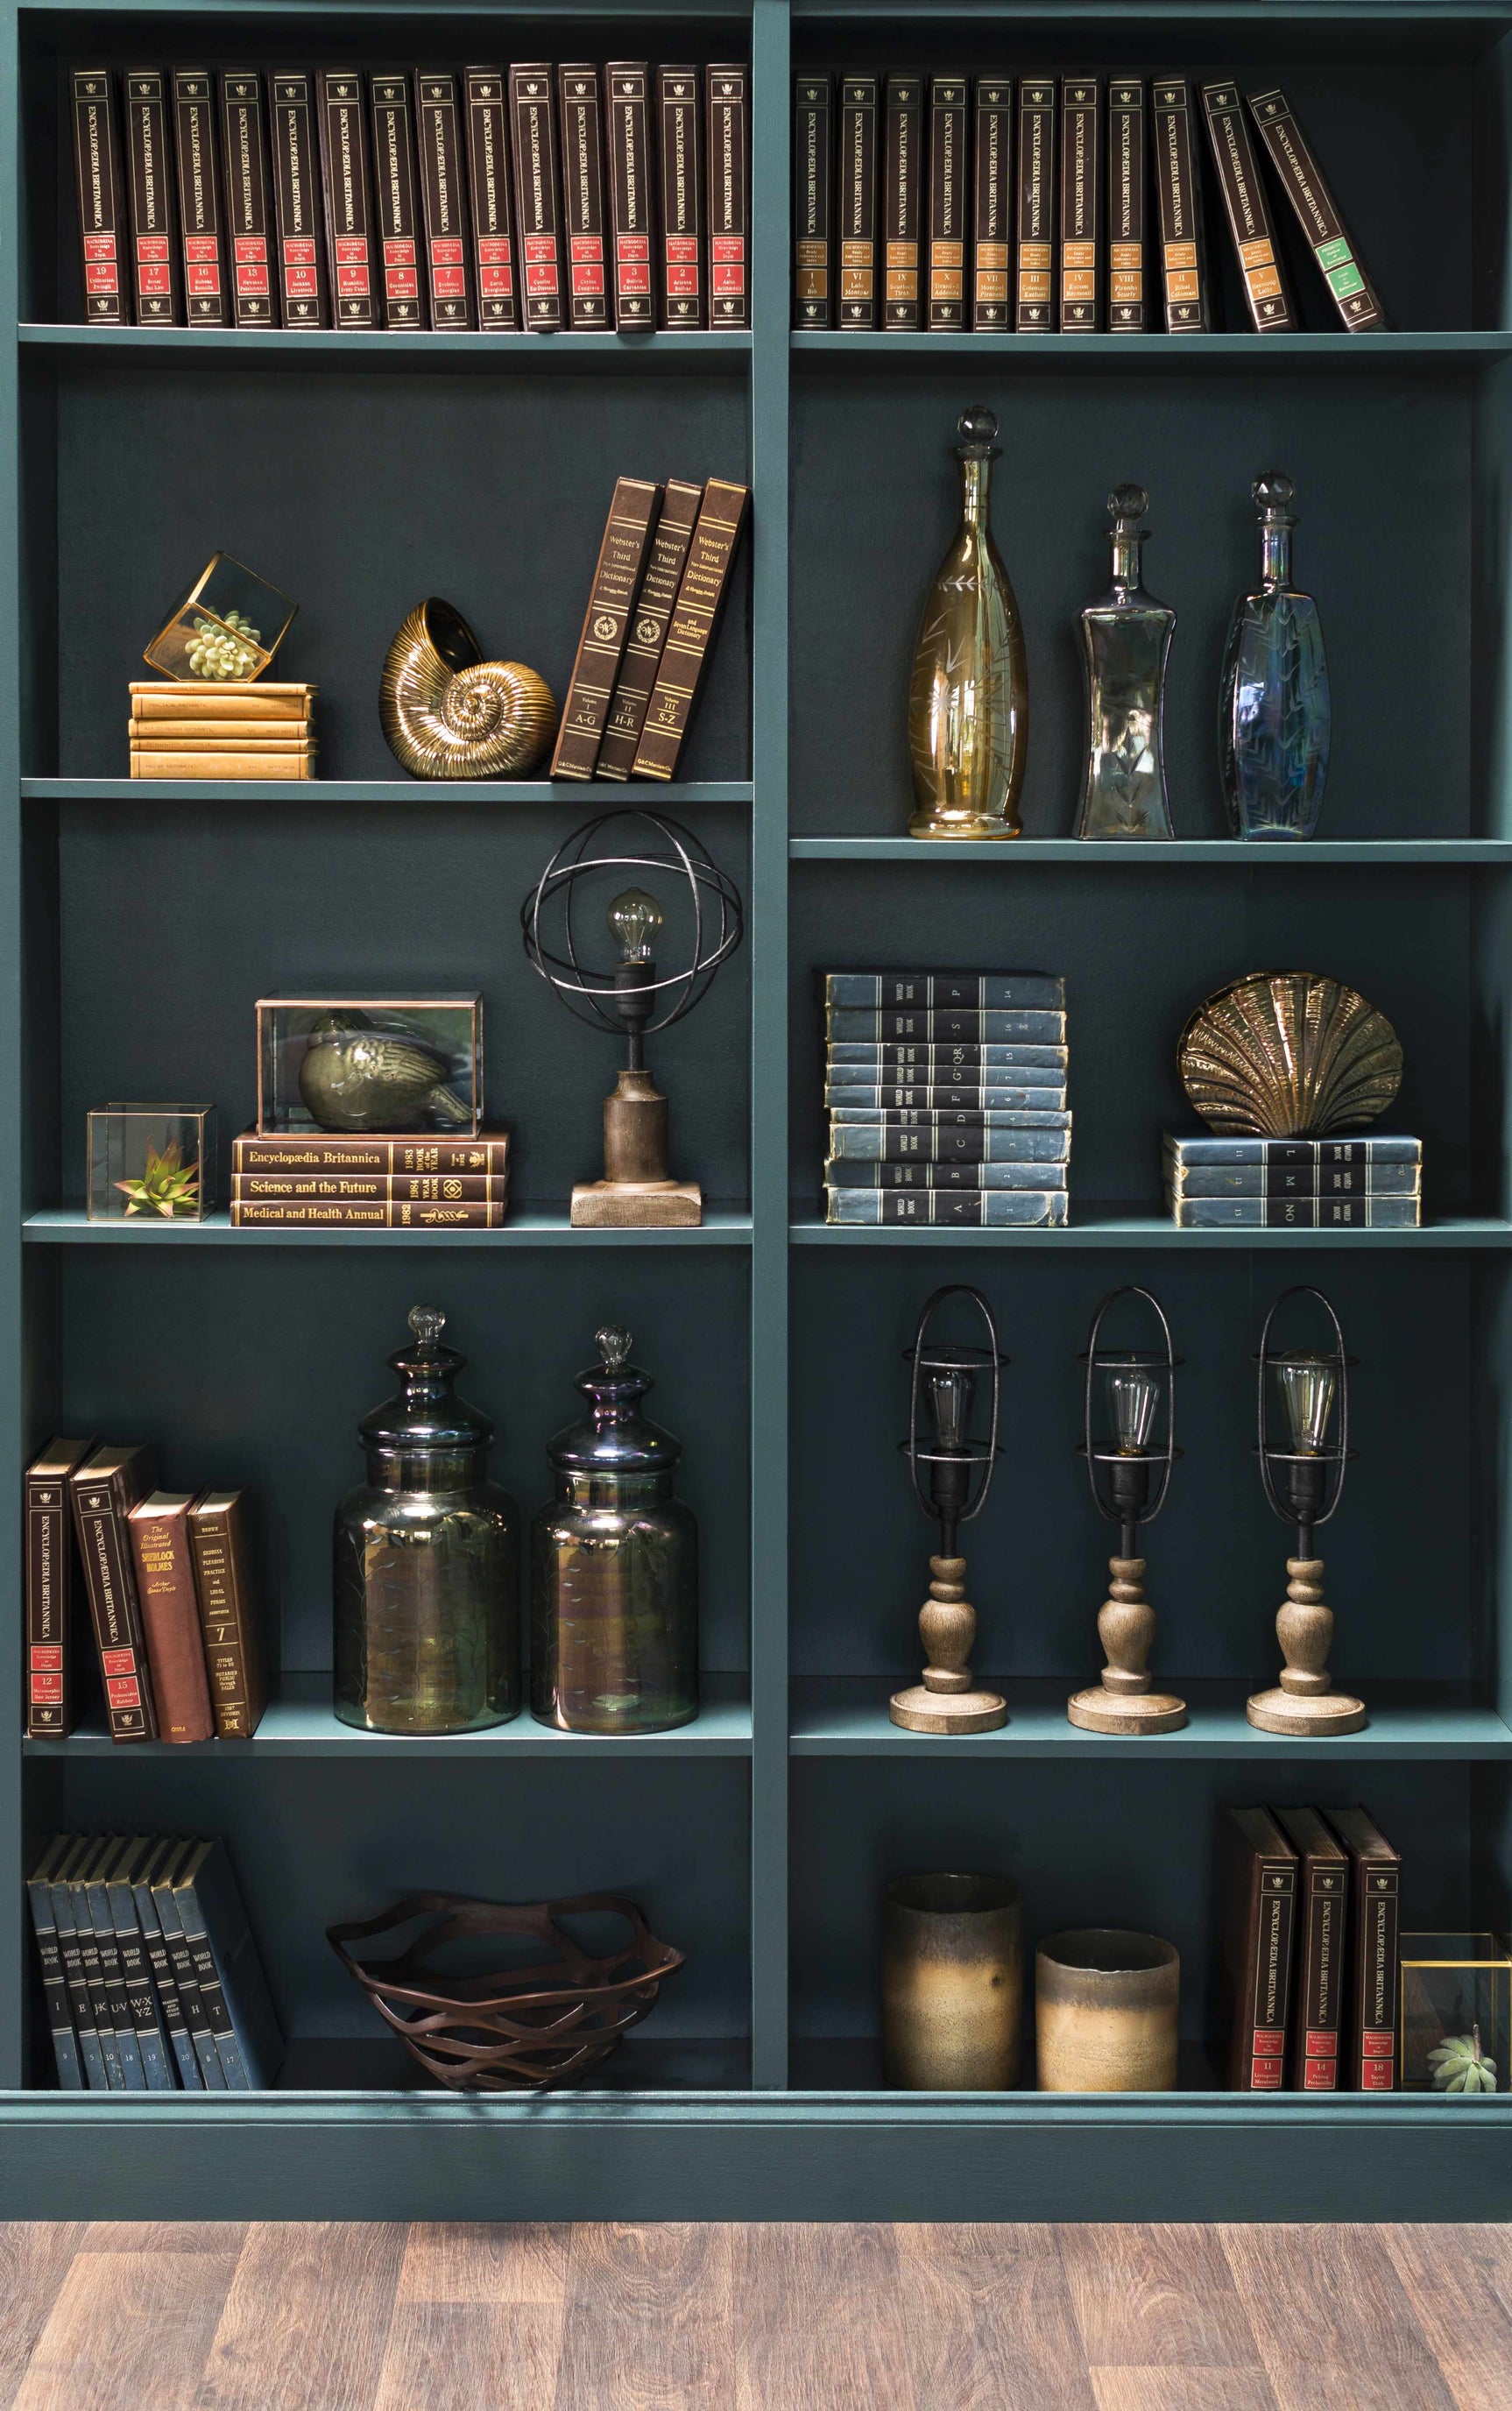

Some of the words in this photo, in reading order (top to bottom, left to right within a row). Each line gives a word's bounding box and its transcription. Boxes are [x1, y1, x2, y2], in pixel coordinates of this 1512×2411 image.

[92, 173, 102, 228] BRITANNICA
[194, 174, 204, 229] BRITANNICA
[438, 178, 449, 232] BRITANNICA
[724, 175, 732, 230] BRITANNICA
[808, 180, 816, 233] BRITANNICA
[853, 180, 862, 234] BRITANNICA
[943, 180, 952, 234] BRITANNICA
[1031, 181, 1041, 237] BRITANNICA
[1238, 182, 1255, 236] BRITANNICA
[1302, 186, 1327, 237] BRITANNICA
[611, 535, 640, 548] Webster's
[655, 539, 685, 552] Webster's
[698, 536, 729, 551] Webster's
[613, 551, 631, 561] Third
[658, 554, 676, 564] Third
[701, 552, 719, 563] Third
[599, 570, 634, 584] Dictionary
[646, 574, 675, 588] Dictionary
[687, 570, 721, 586] Dictionary
[576, 714, 596, 725] A-G
[615, 716, 634, 727] H-R
[659, 714, 676, 725] S-Z
[324, 1153, 380, 1163] Britannica
[251, 1182, 293, 1193] Science
[295, 1182, 316, 1193] and
[319, 1182, 337, 1193] the
[340, 1181, 377, 1193] Future
[1286, 1177, 1295, 1185] M
[410, 1179, 419, 1198] 1984
[244, 1208, 284, 1218] Medical
[286, 1208, 306, 1218] and
[308, 1208, 342, 1219] Health
[345, 1209, 384, 1220] Annual
[402, 1205, 411, 1225] 1982
[143, 1533, 169, 1542] Original
[141, 1551, 174, 1561] SHERLOCK
[146, 1562, 173, 1572] HOLMES
[104, 1587, 118, 1644] BRITANNICA
[217, 1628, 224, 1641] 7
[122, 1948, 140, 1958] WORLD
[126, 1958, 141, 1967] BOOK
[154, 1959, 168, 1969] BOOK
[198, 1961, 213, 1971] BOOK
[1266, 1969, 1277, 2022] BRITANNICA
[1374, 1969, 1384, 2024] BRITANNICA
[191, 2005, 201, 2014] H
[213, 2006, 220, 2015] T
